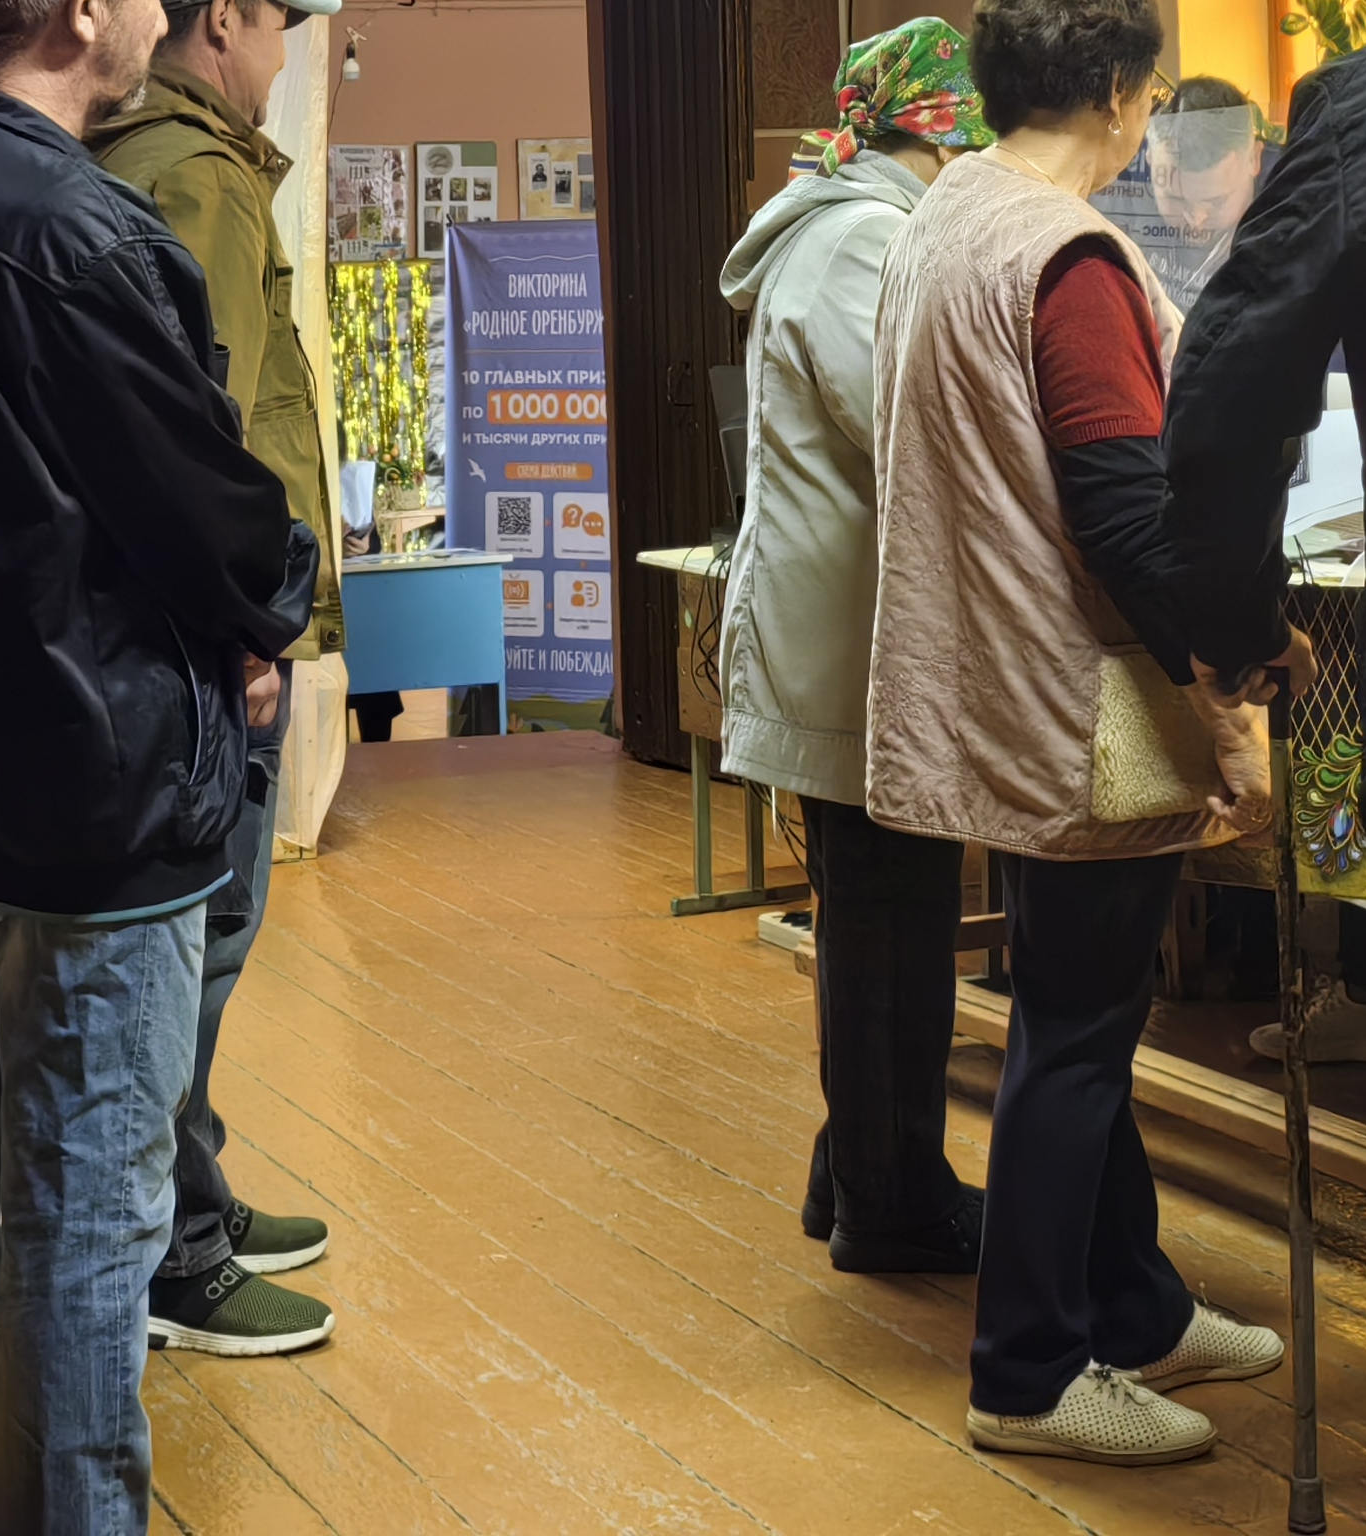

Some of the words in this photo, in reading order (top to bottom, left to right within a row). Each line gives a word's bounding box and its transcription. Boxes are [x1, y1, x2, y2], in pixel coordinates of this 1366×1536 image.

[508, 272, 588, 298] ВИКТОРИНА
[463, 310, 528, 339] «РОДНОЕ
[462, 370, 480, 385] 10
[484, 369, 563, 385] ГЛАВНЫХ
[462, 406, 483, 419] ПО
[462, 433, 471, 444] И
[475, 433, 528, 444] ТЫСЯЧИ
[531, 433, 580, 446] ДРУГИХ
[538, 648, 546, 671] И
